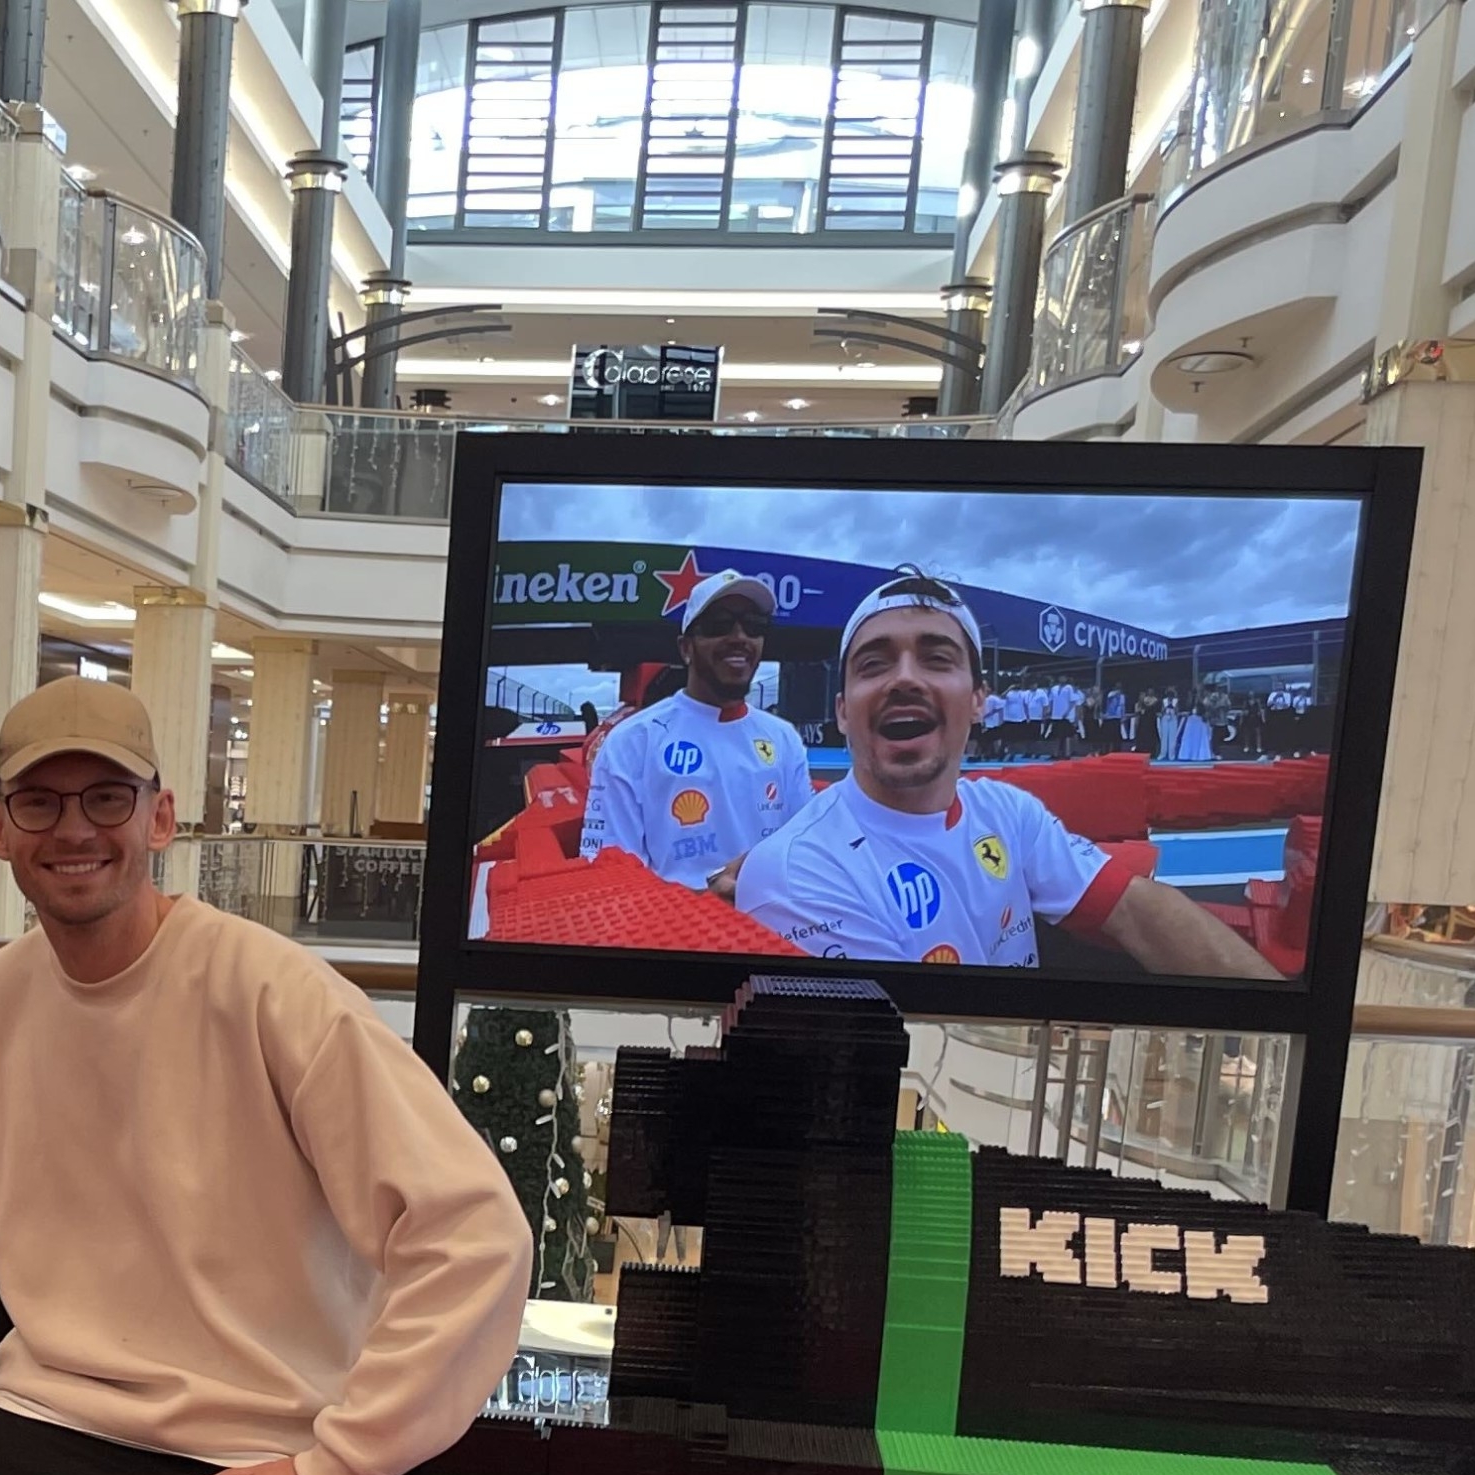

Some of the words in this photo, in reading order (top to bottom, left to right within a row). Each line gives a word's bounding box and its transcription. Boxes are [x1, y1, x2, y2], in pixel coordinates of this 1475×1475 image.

[1074, 621, 1168, 661] crypto.com
[667, 740, 701, 775] hp
[672, 833, 718, 860] IBM
[354, 859, 422, 874] COFFEE
[888, 863, 938, 930] hp
[1000, 1207, 1269, 1304] KICK
